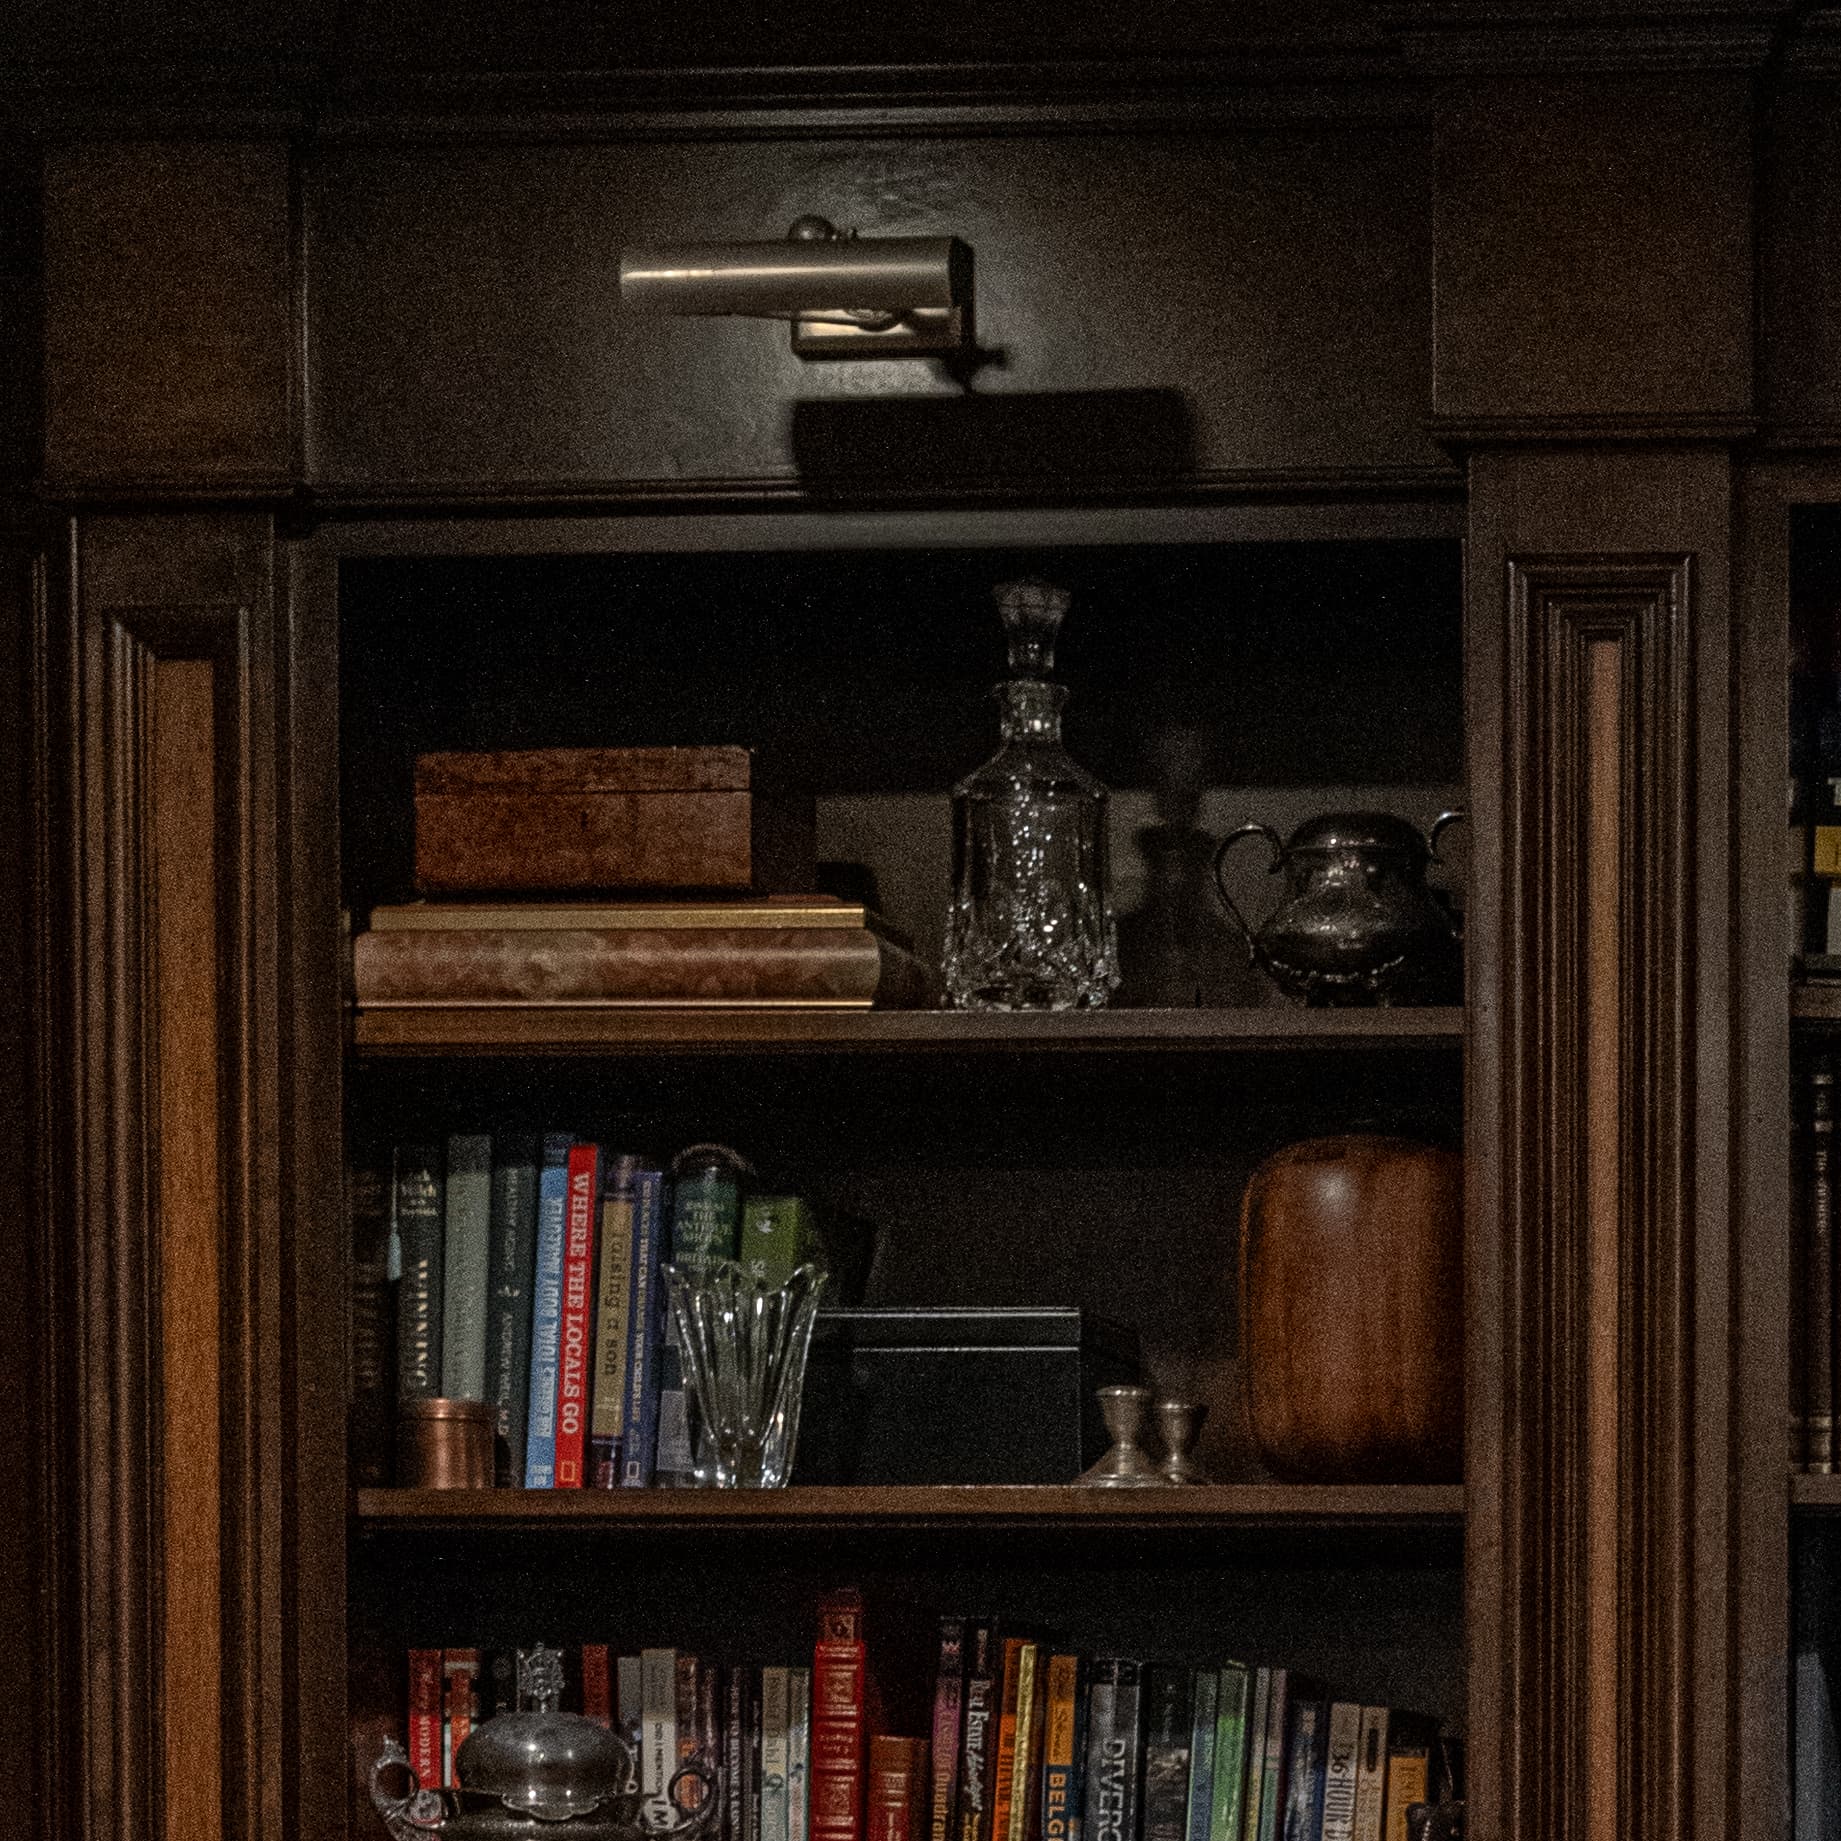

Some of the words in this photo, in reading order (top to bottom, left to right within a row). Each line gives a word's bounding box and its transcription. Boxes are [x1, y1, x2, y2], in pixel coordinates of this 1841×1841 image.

[568, 1171, 590, 1257] WHERE
[638, 1238, 648, 1266] THAT
[565, 1262, 587, 1309] THE
[636, 1266, 647, 1289] CAN
[538, 1279, 559, 1318] BODY
[605, 1317, 619, 1332] a
[561, 1313, 584, 1398] LOCALS
[603, 1338, 619, 1377] son
[560, 1402, 579, 1435] GO
[967, 1678, 990, 1708] REAL
[418, 1715, 430, 1777] MODERN
[653, 1722, 664, 1744] DID
[763, 1733, 781, 1765] Dahl
[966, 1711, 989, 1751] ESTATE
[652, 1748, 663, 1793] MENTION
